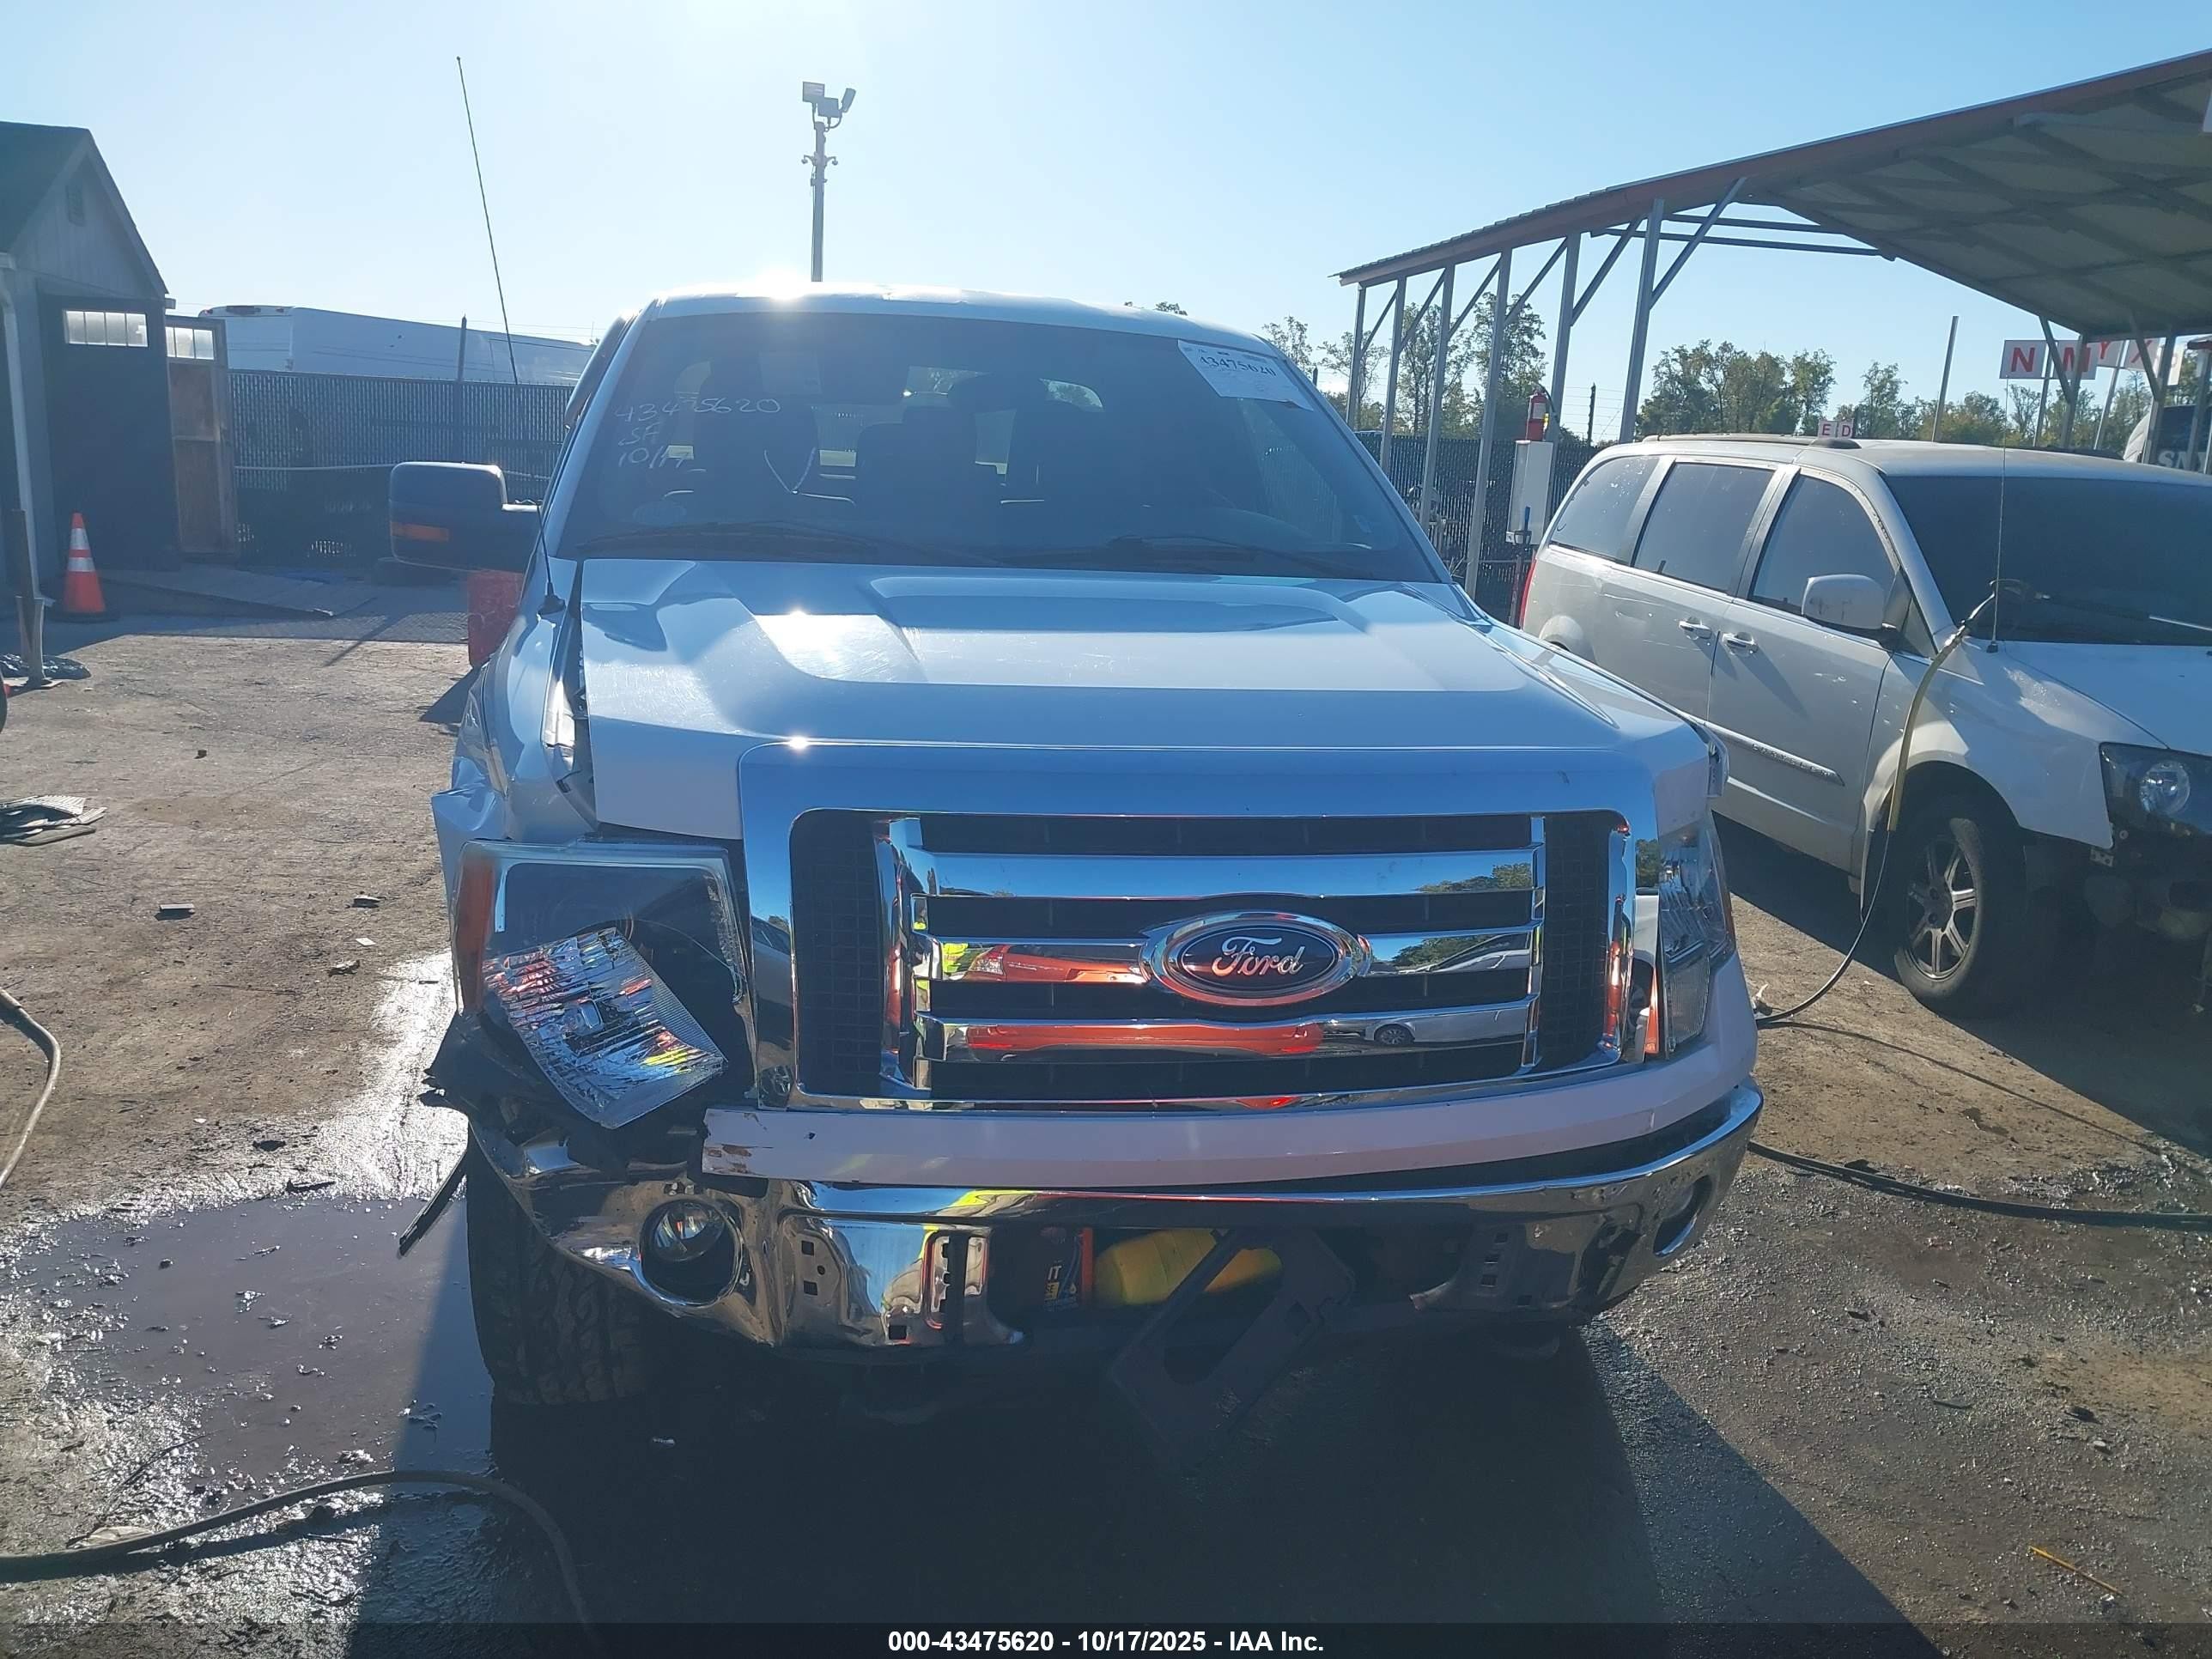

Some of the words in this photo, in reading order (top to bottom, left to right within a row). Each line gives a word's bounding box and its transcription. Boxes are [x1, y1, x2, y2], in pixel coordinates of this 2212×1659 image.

[2011, 347, 2036, 373] N
[1822, 423, 1832, 436] E
[1841, 424, 1851, 437] D
[1212, 936, 1305, 976] Ford
